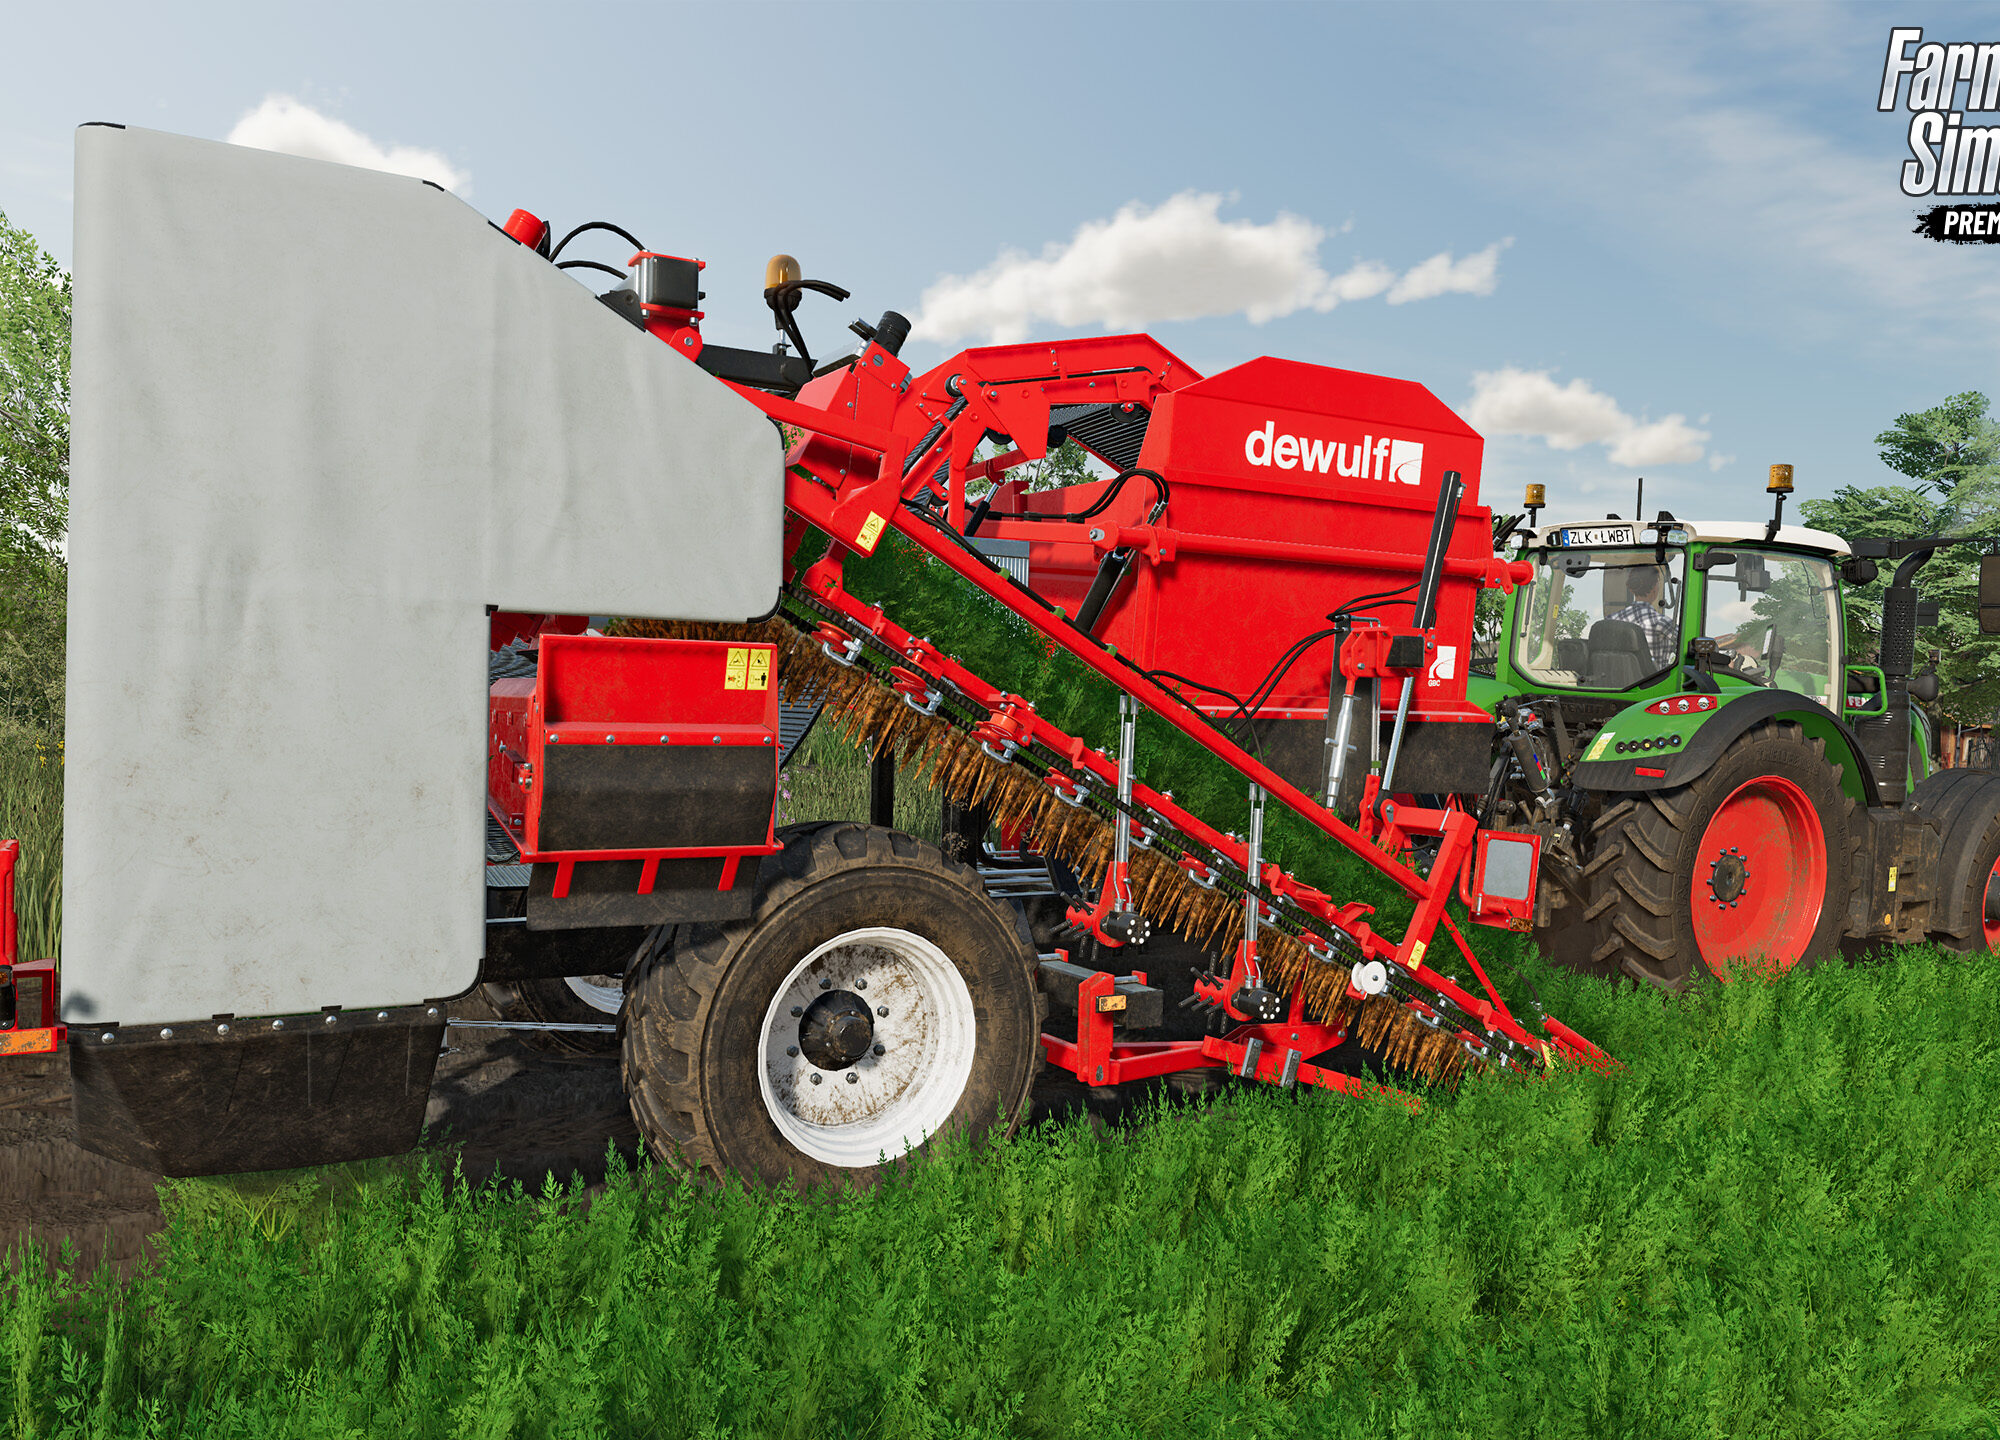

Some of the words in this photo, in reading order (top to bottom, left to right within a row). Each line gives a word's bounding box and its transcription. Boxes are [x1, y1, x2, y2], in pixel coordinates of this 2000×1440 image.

[1244, 420, 1391, 481] dewulf
[1570, 531, 1593, 544] ZLK
[1600, 529, 1631, 544] LWBT
